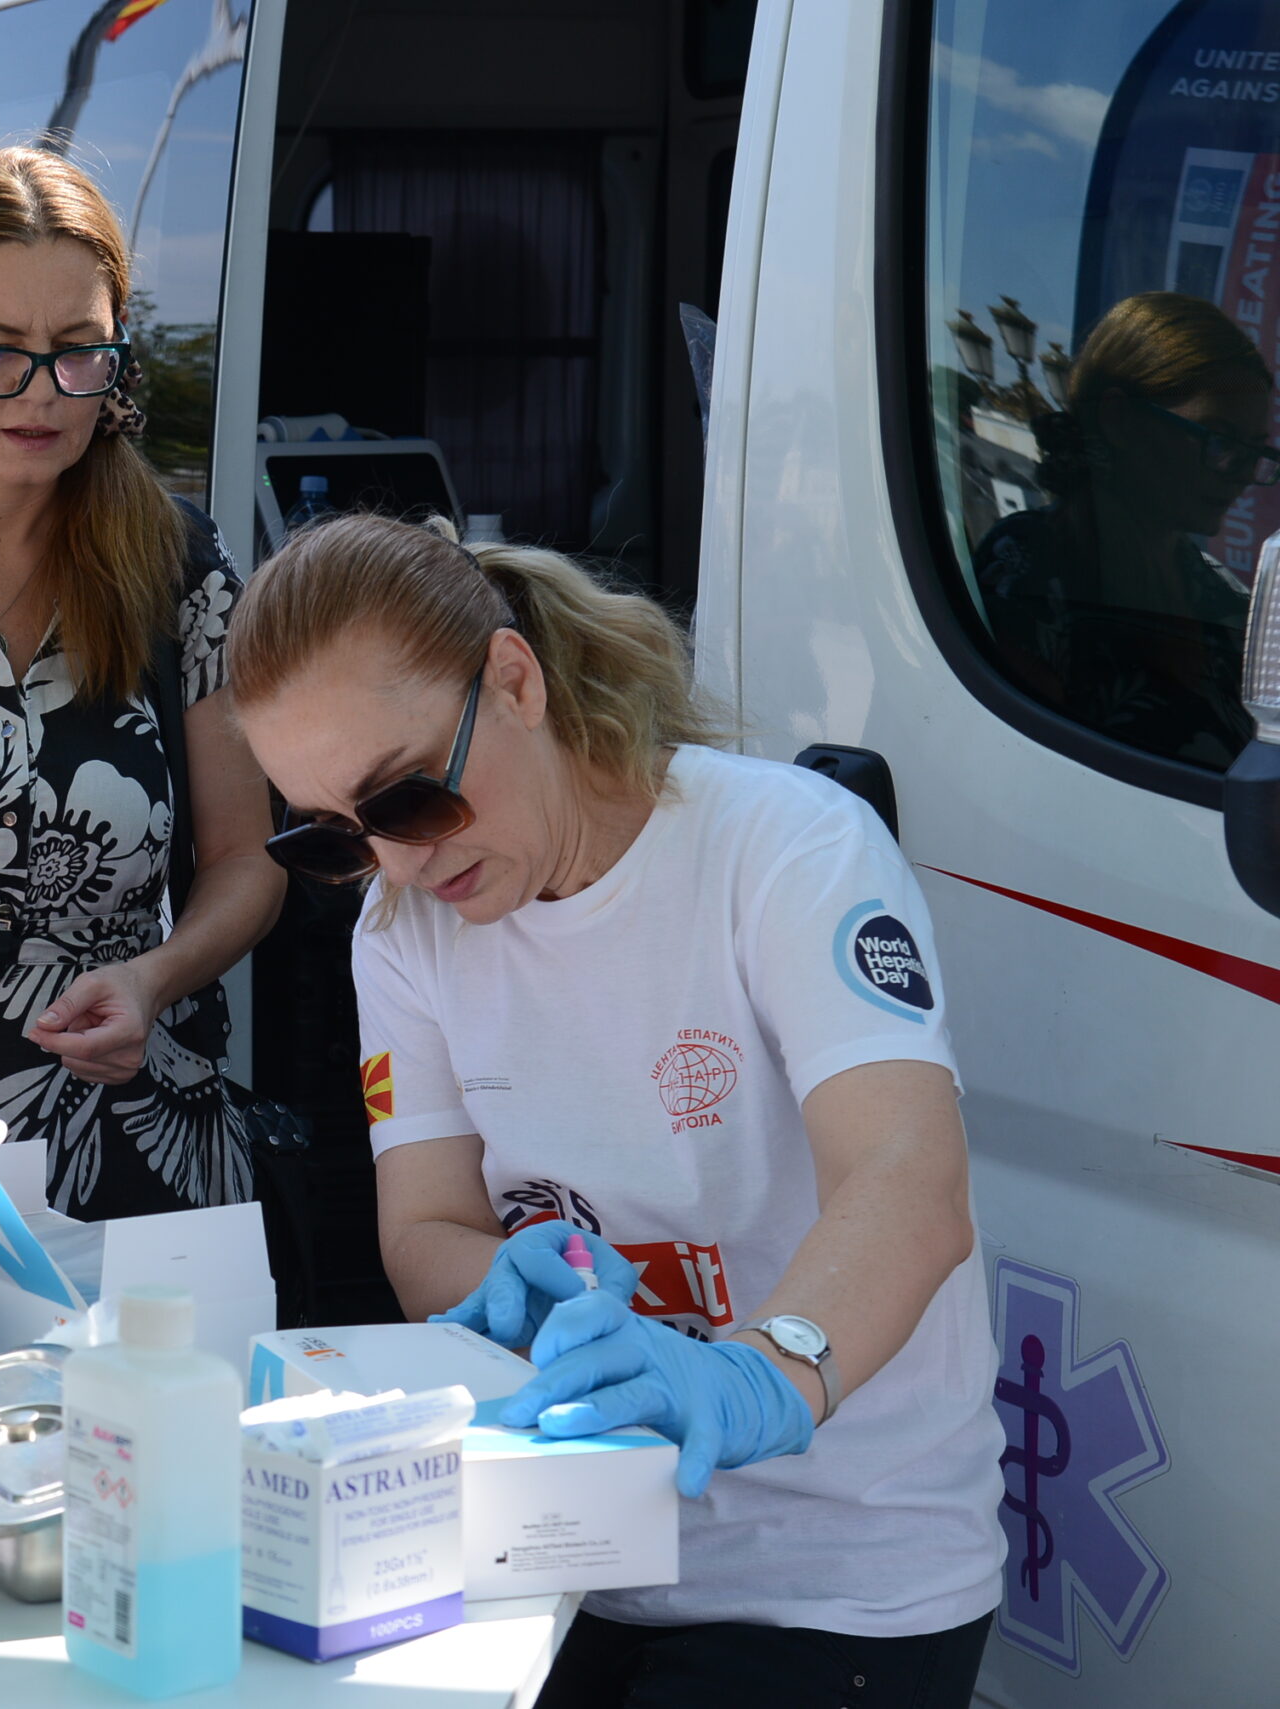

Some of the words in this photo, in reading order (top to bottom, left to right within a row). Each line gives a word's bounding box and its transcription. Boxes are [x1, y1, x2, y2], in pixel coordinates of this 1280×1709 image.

[858, 936, 912, 956] World
[870, 968, 909, 989] Day
[673, 1241, 728, 1318] it
[261, 1468, 310, 1501] MED
[325, 1467, 407, 1503] ASTRA
[412, 1451, 461, 1487] MED
